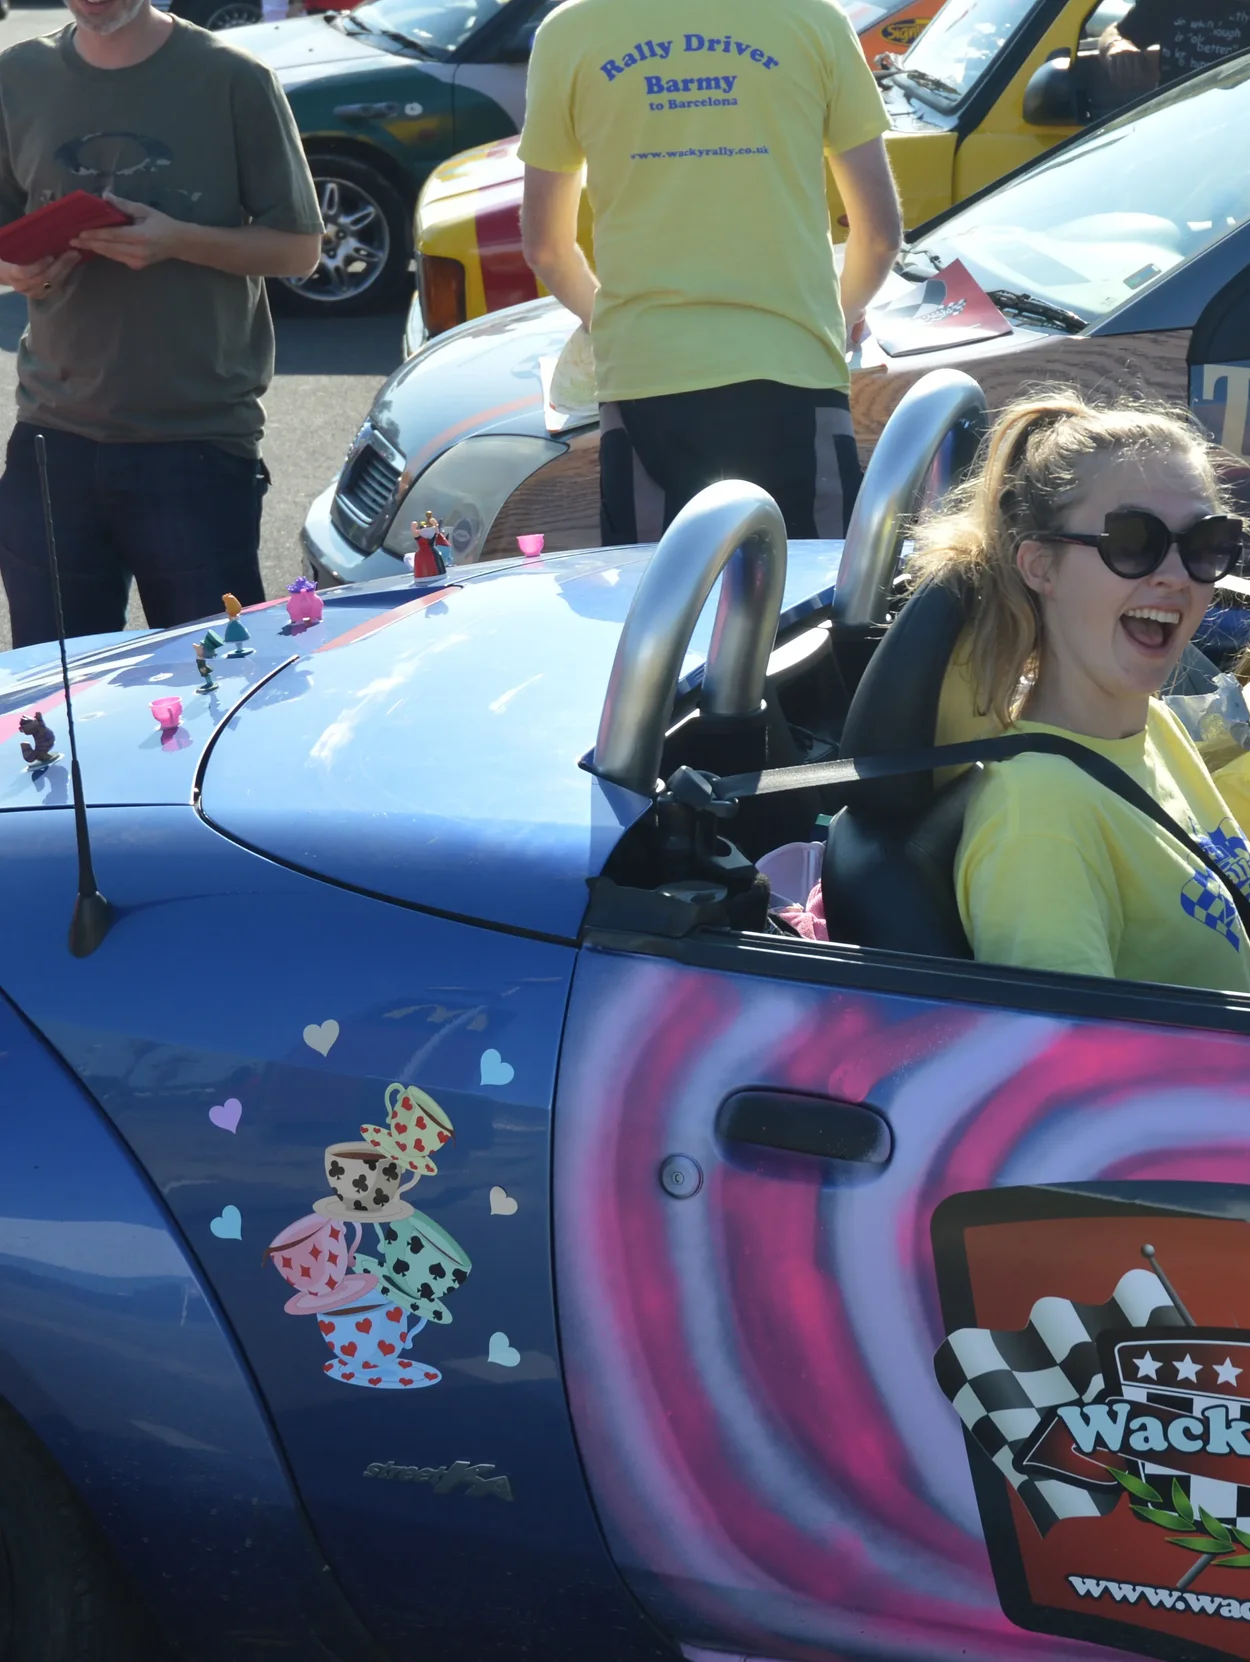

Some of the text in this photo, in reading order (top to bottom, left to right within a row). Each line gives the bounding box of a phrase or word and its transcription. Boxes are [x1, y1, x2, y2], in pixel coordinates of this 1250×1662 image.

[600, 34, 779, 81] Rally Driver
[644, 75, 737, 95] Barmy
[649, 97, 738, 112] to Barcelona
[630, 145, 770, 160] www.wackyrally.co.uk
